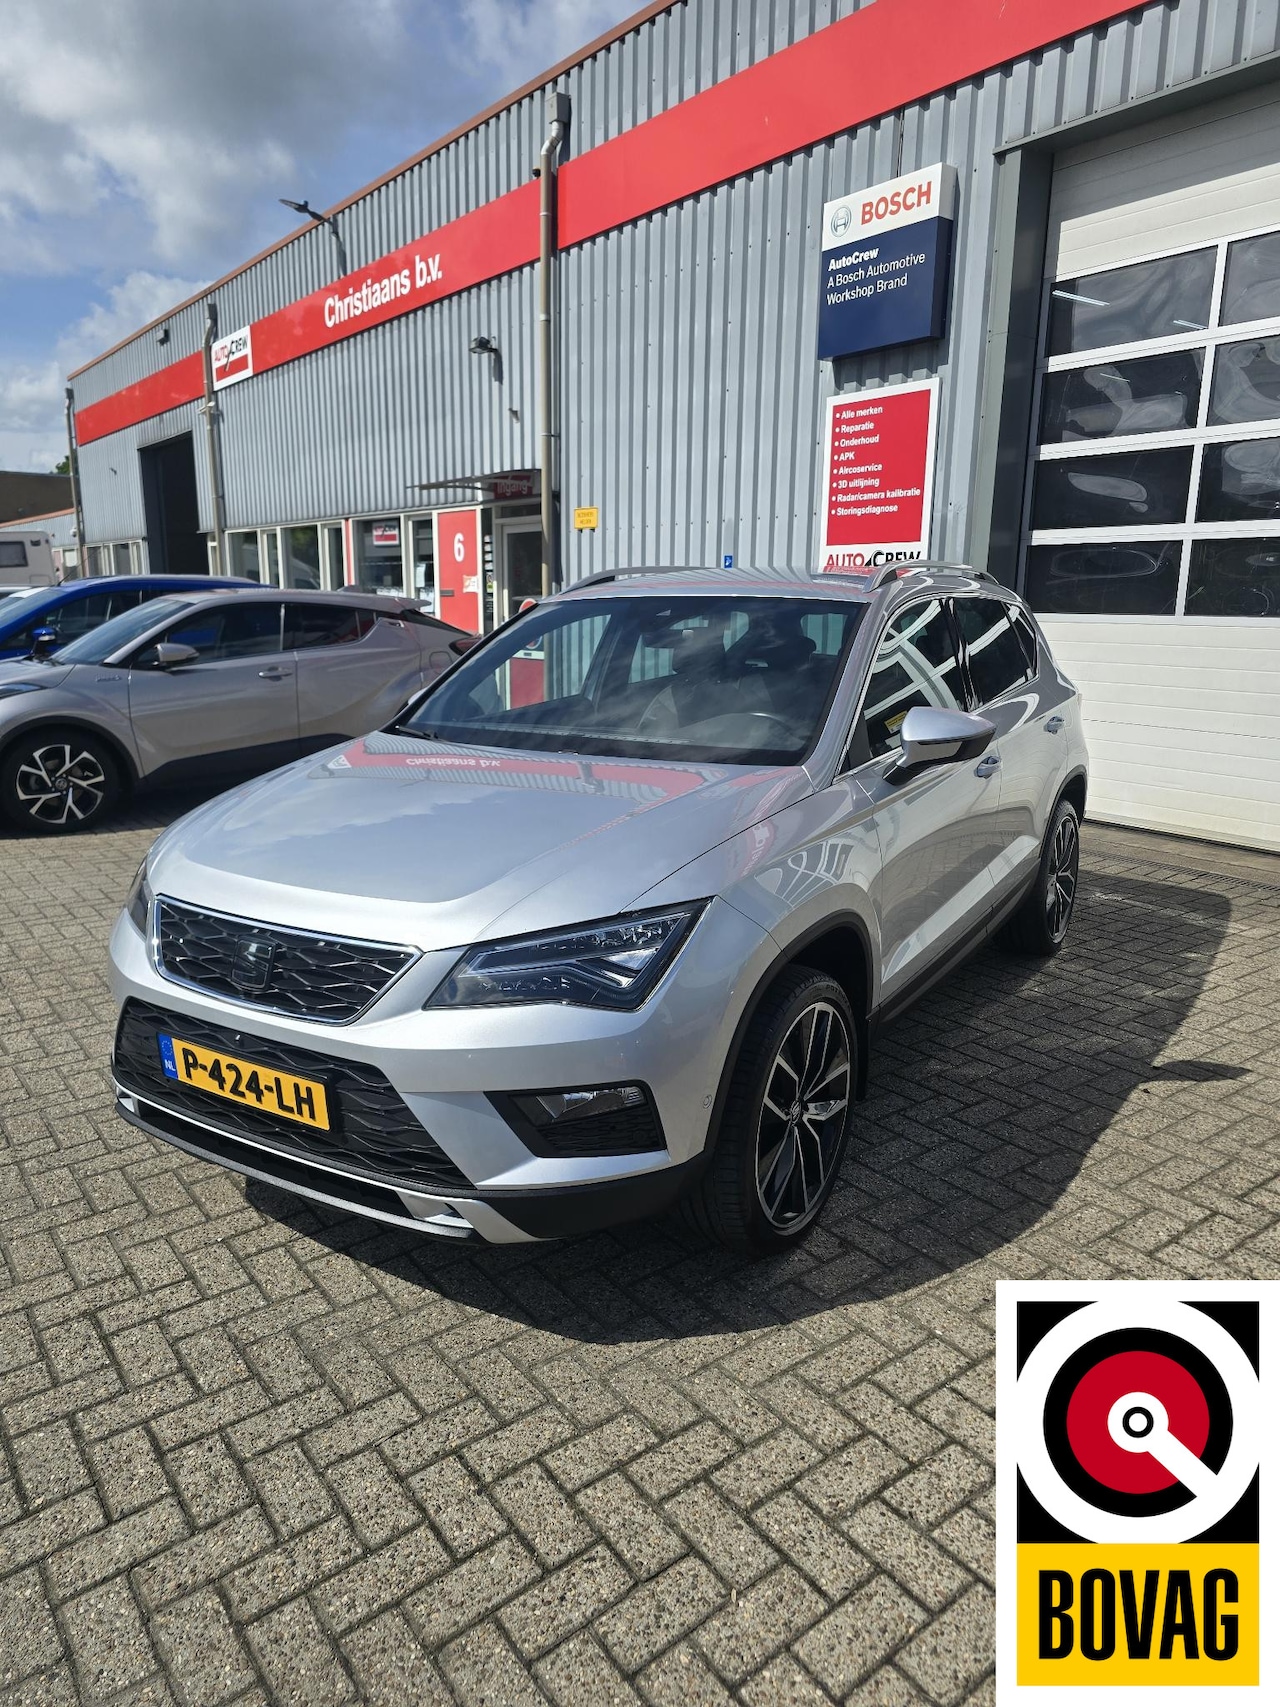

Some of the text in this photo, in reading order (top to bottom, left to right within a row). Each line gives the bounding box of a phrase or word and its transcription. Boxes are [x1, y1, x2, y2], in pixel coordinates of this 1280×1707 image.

[860, 181, 932, 226] BOSCH
[828, 248, 880, 272] AutoCrew
[827, 253, 926, 289] A Bosch Automotive
[324, 254, 443, 328] Christiaans b.v.
[827, 272, 908, 306] Workshop Brand
[840, 406, 883, 420] Alle merken
[840, 420, 875, 434] Reparatie
[840, 434, 880, 448] Onderhoud
[839, 451, 855, 462] APK
[838, 463, 883, 475] Aircoservice
[837, 477, 880, 489] 3D uitlijning
[886, 487, 921, 499] kalibratie
[836, 504, 899, 517] Storingsdiagnose
[453, 532, 465, 563] 6
[164, 1059, 176, 1072] NL
[181, 1047, 317, 1121] P-424-LH
